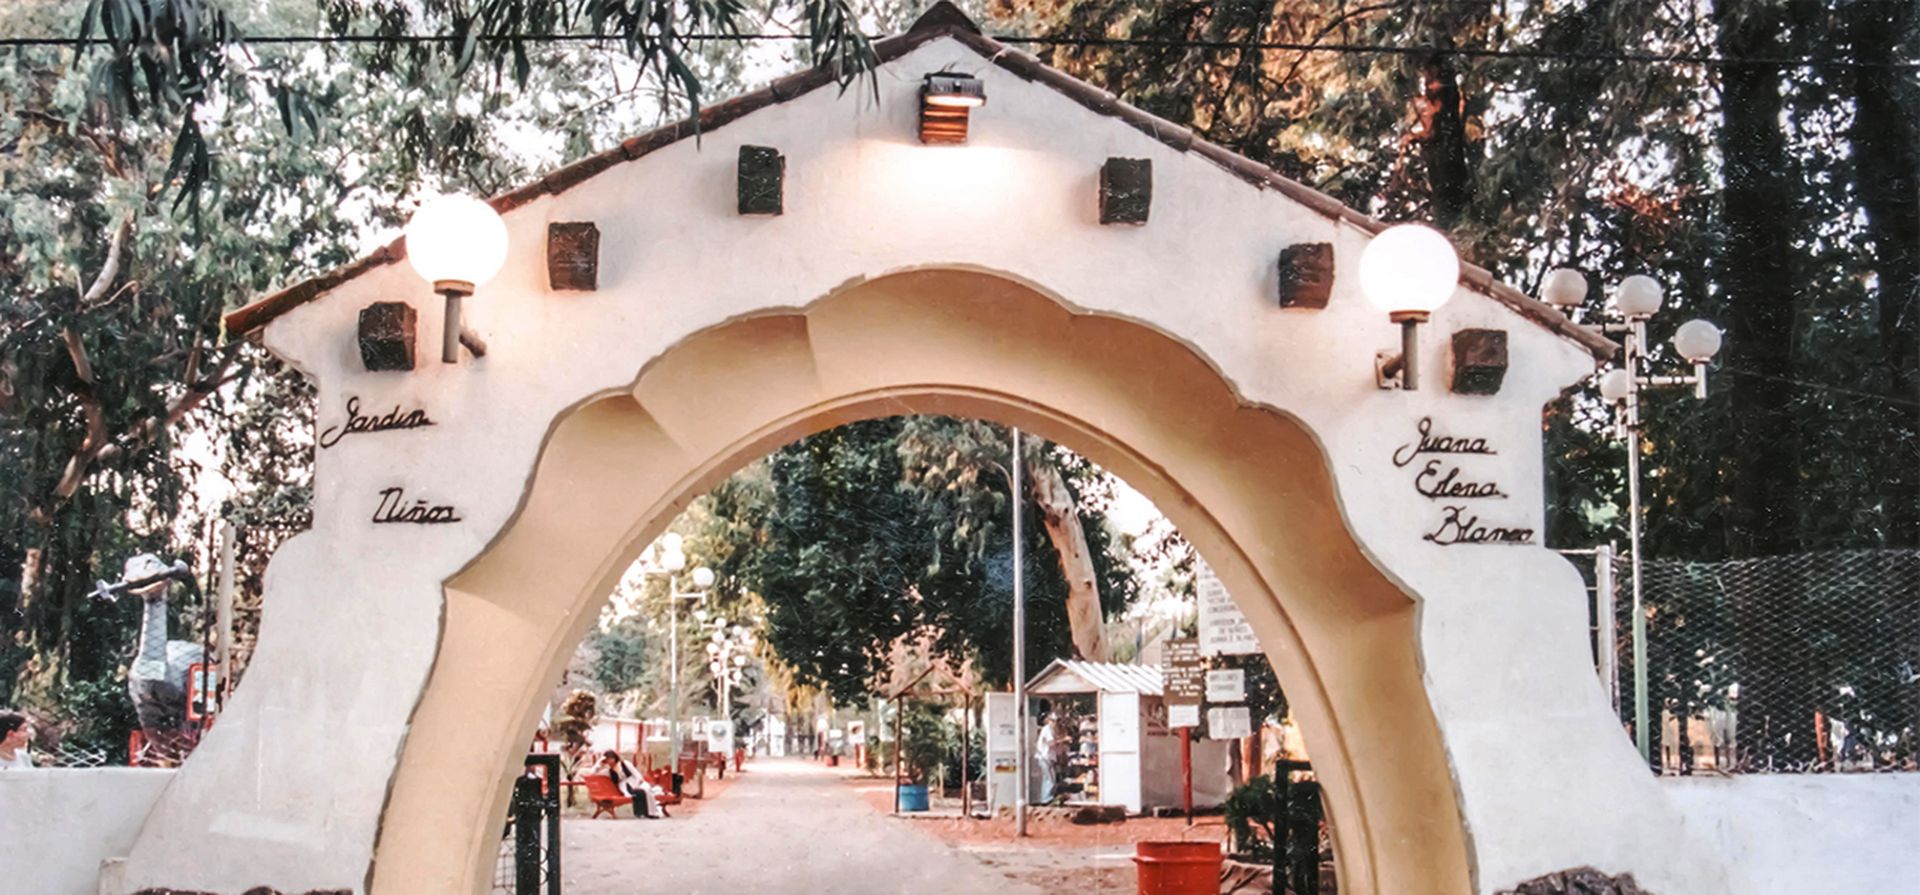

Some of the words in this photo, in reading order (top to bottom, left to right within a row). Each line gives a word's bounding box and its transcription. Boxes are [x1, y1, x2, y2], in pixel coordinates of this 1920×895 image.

[320, 396, 437, 449] Jardin
[1393, 416, 1498, 467] Juana
[1415, 459, 1509, 499] Elena
[372, 487, 462, 524] Niños
[1423, 506, 1536, 545] Blanco
